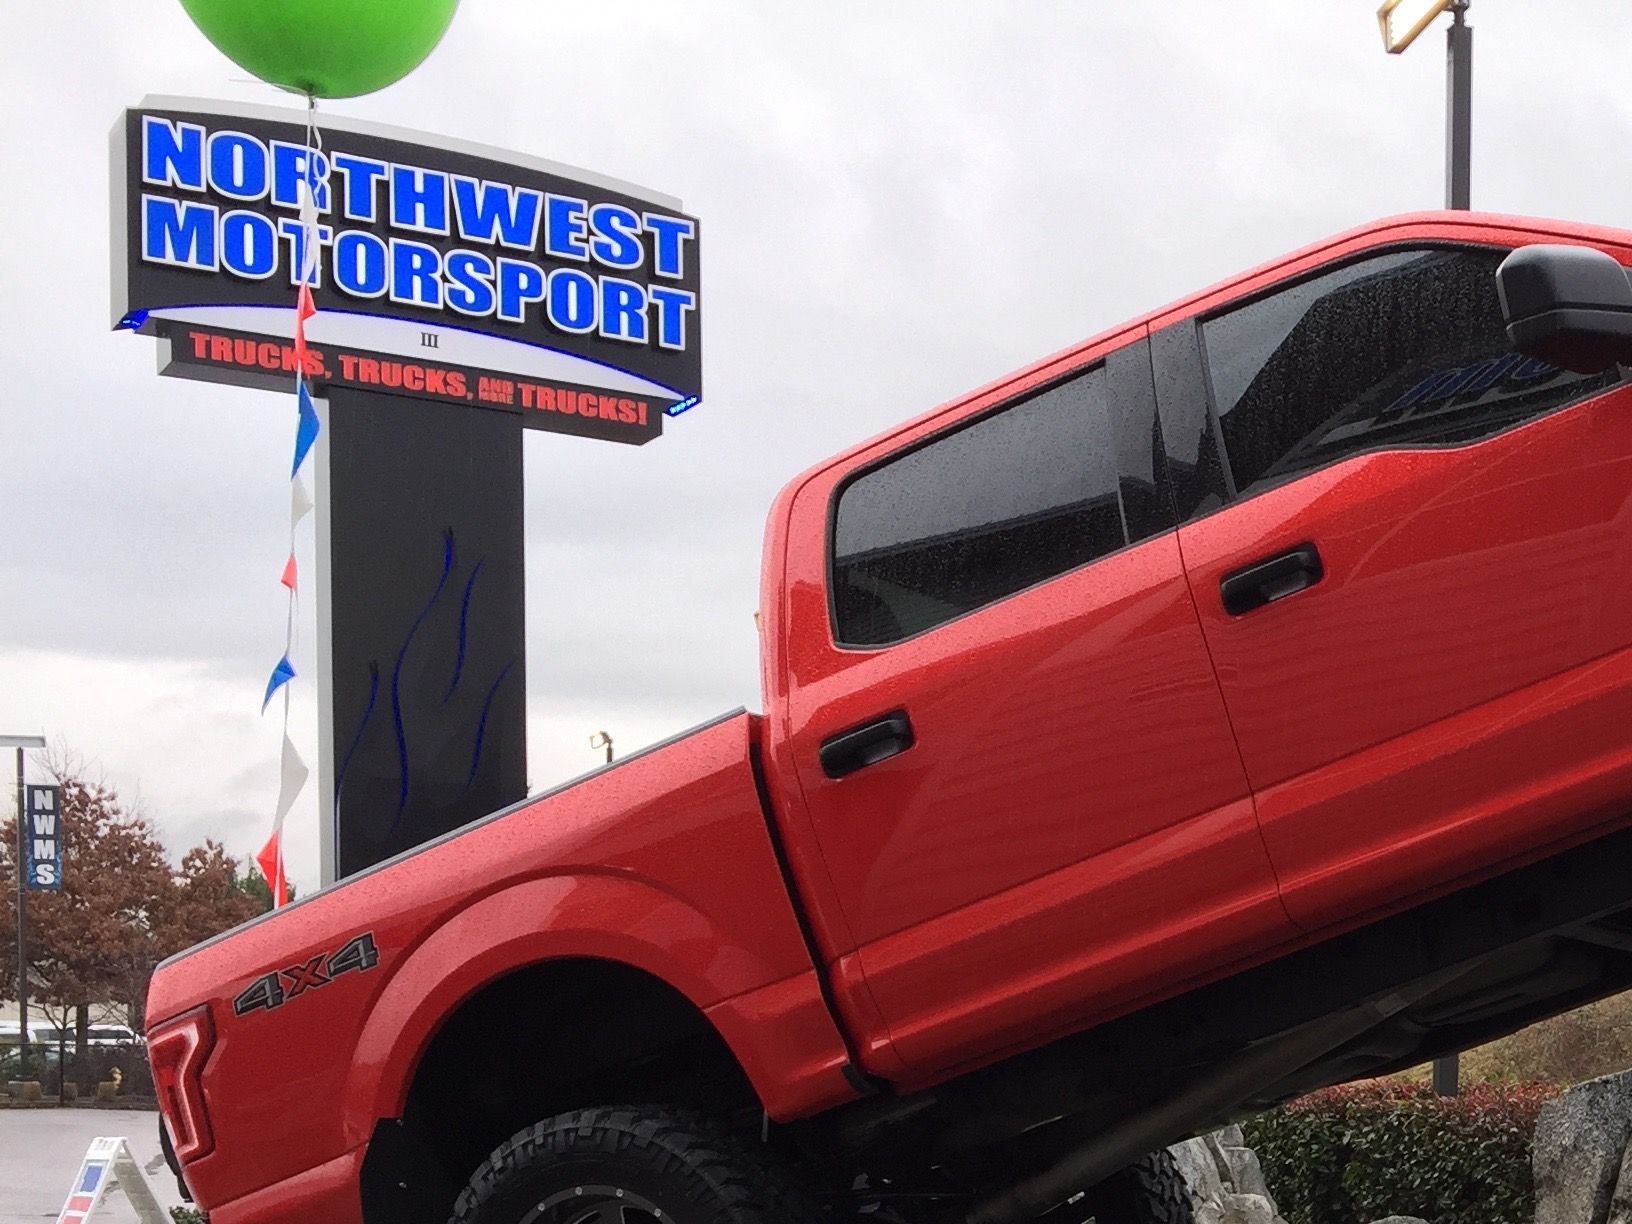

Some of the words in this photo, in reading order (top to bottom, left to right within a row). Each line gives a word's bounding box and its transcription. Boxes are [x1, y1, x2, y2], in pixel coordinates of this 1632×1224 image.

[142, 115, 694, 280] NORTHWEST
[142, 195, 695, 350] MOTORSPORT
[189, 331, 332, 379] TRUCKS,
[338, 355, 474, 400] TRUCKS,
[518, 383, 648, 426] TRUCKS!
[33, 789, 55, 885] NWMS
